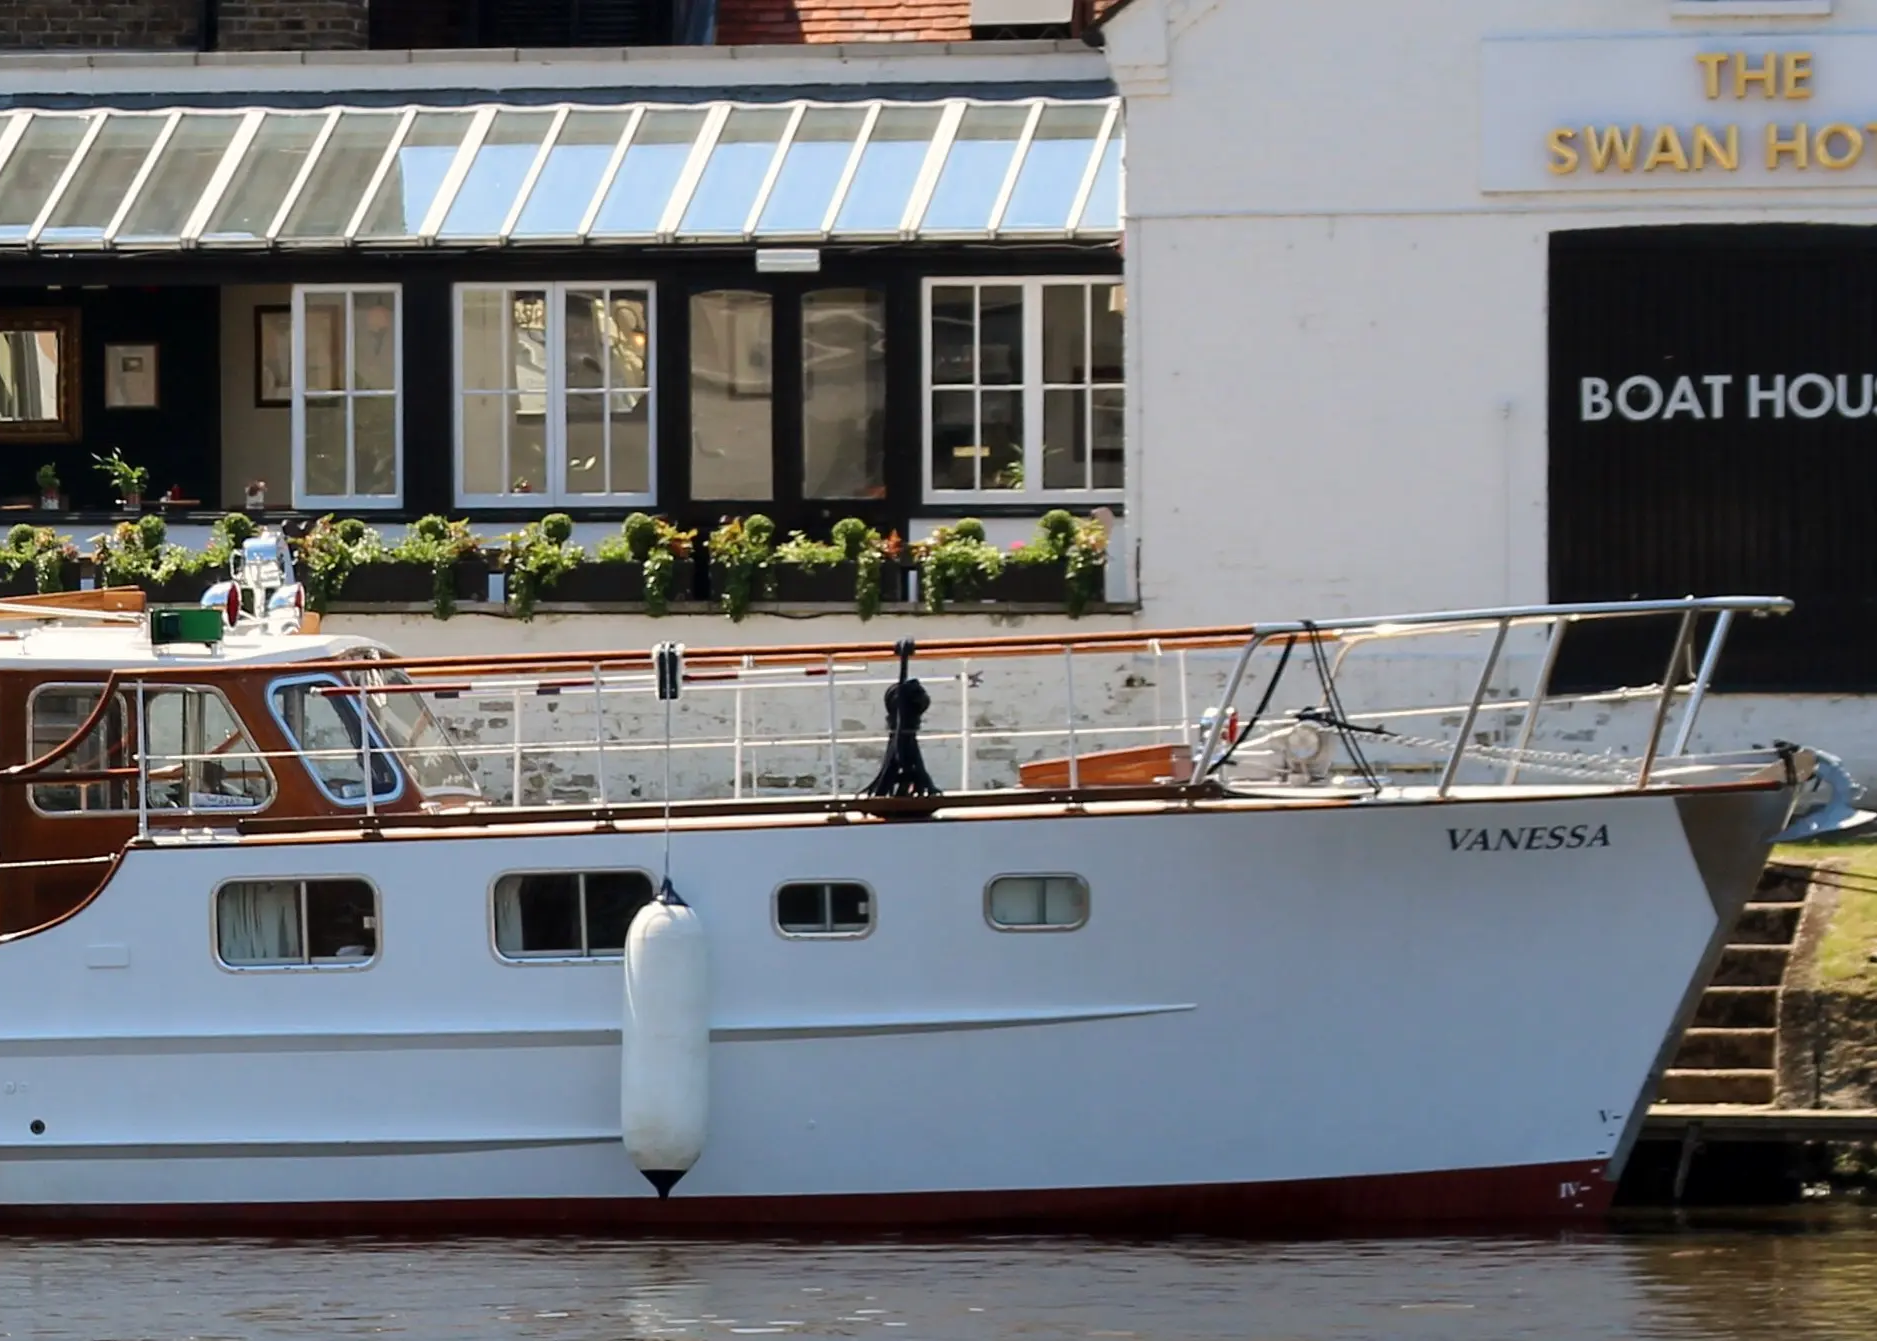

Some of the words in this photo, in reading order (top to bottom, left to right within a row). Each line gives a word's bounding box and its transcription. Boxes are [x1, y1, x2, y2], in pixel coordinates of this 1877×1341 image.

[1694, 51, 1812, 99] THE
[1546, 123, 1739, 174] SWAN
[1580, 374, 1733, 421] BOAT
[1748, 373, 1877, 419] HOU
[1446, 824, 1611, 851] VANESSA
